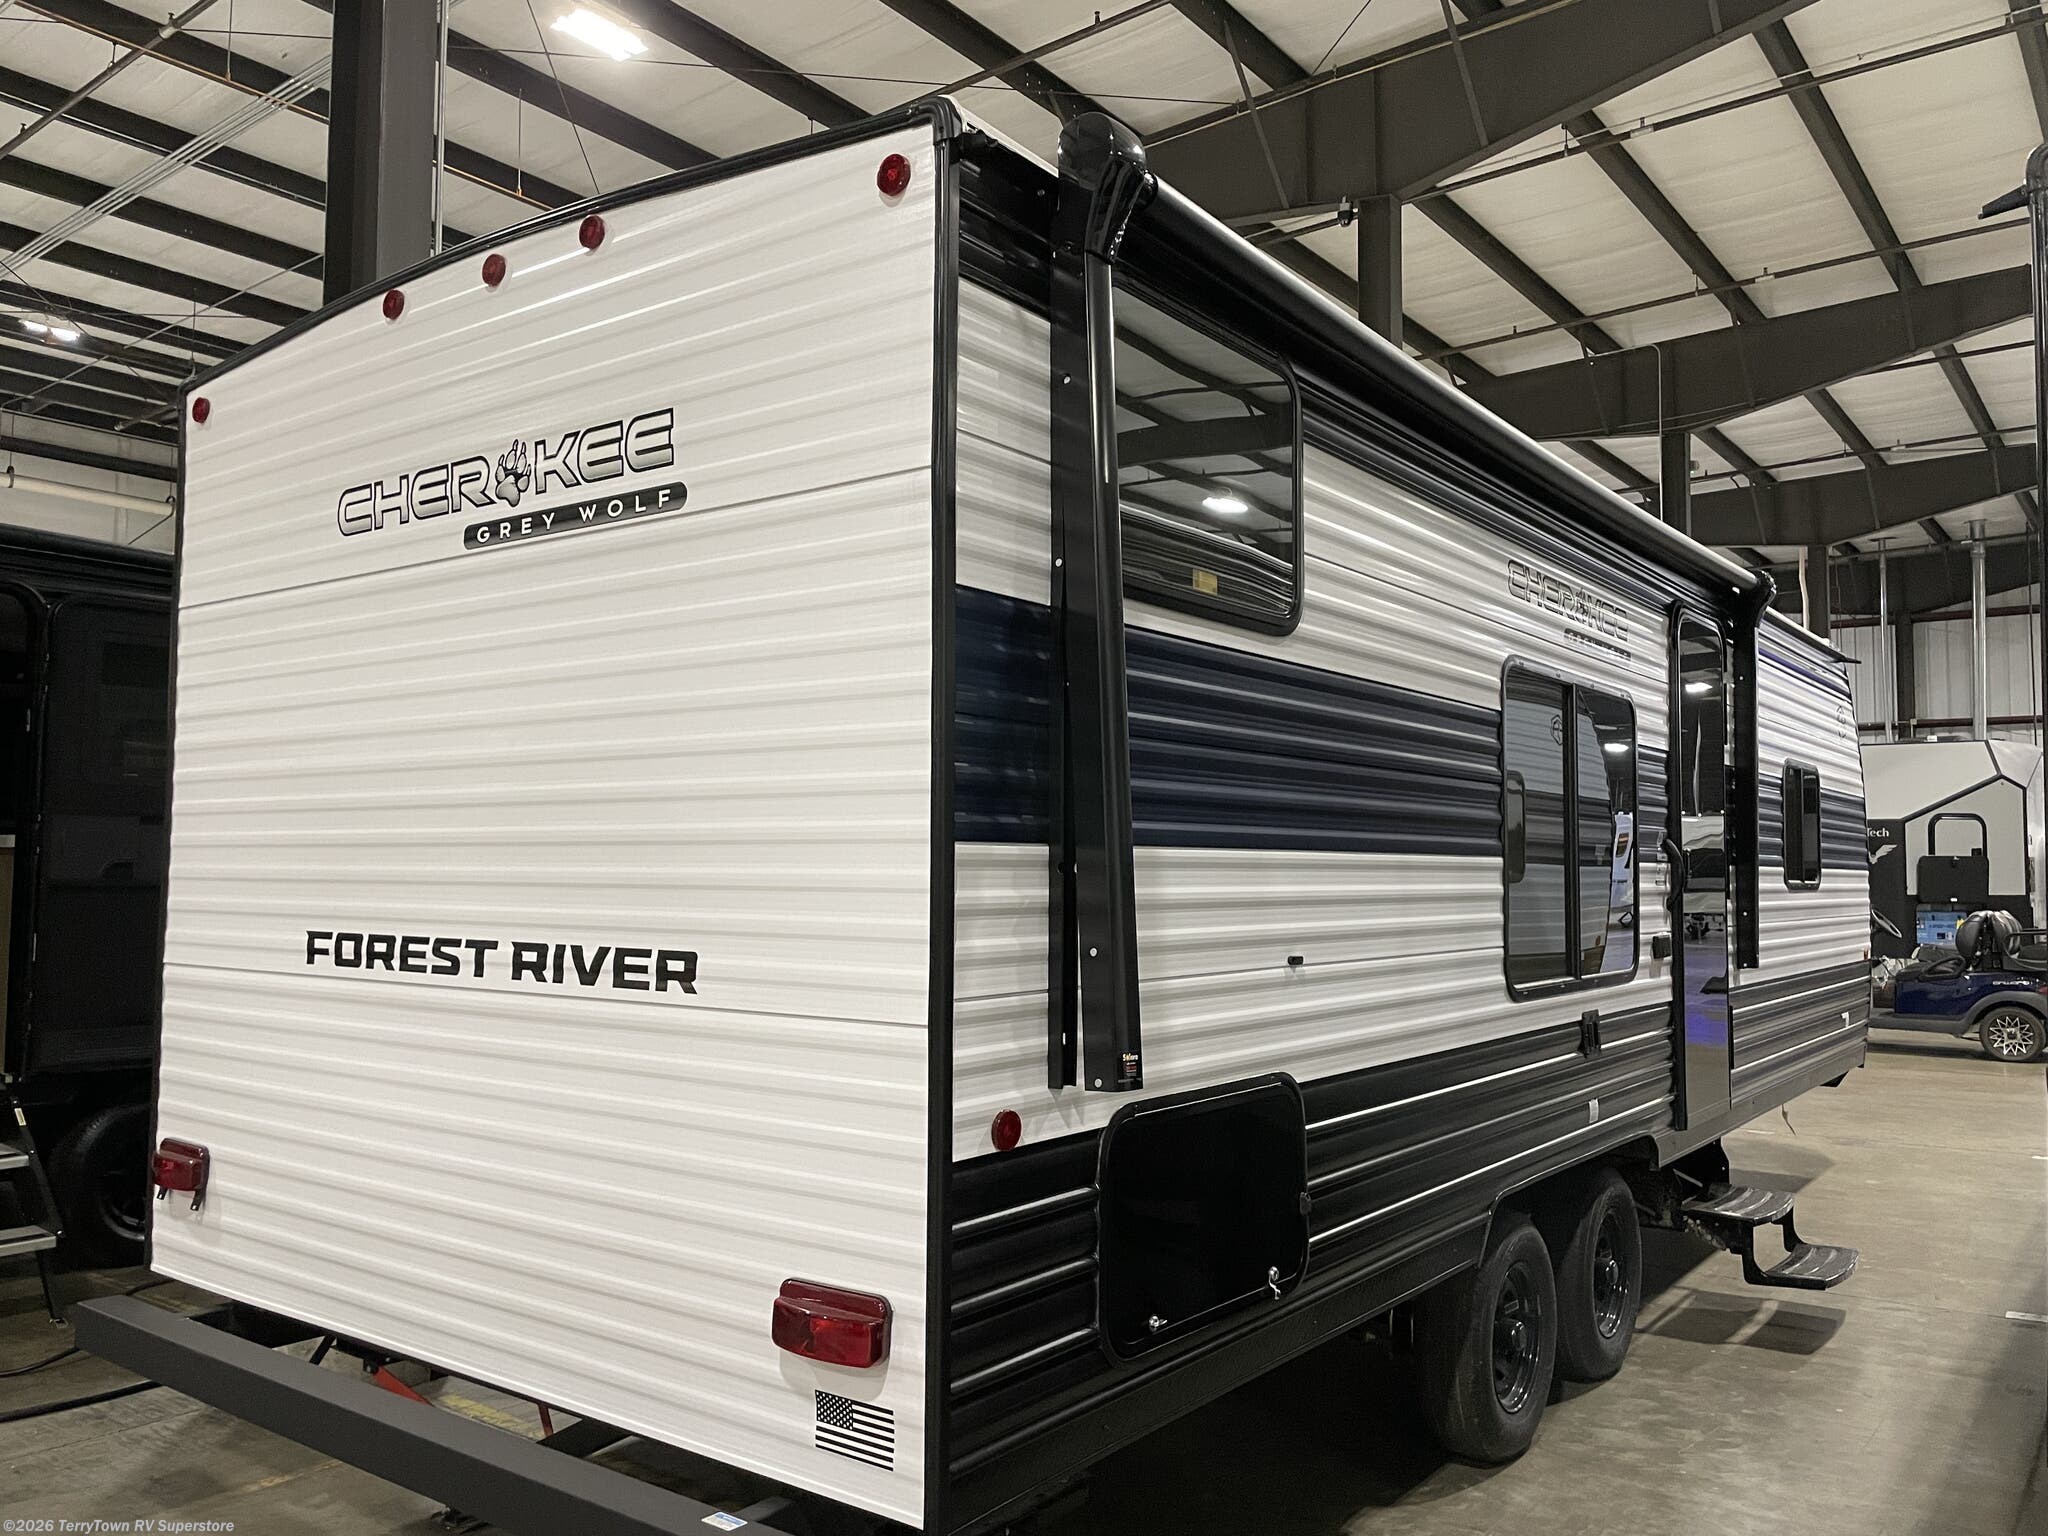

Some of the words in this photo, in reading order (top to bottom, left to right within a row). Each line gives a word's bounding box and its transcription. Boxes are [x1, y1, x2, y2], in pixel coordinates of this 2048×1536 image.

[476, 512, 556, 544] GREY
[579, 488, 671, 523] WOLF
[306, 930, 499, 978] FOREST
[511, 941, 698, 995] RIVER
